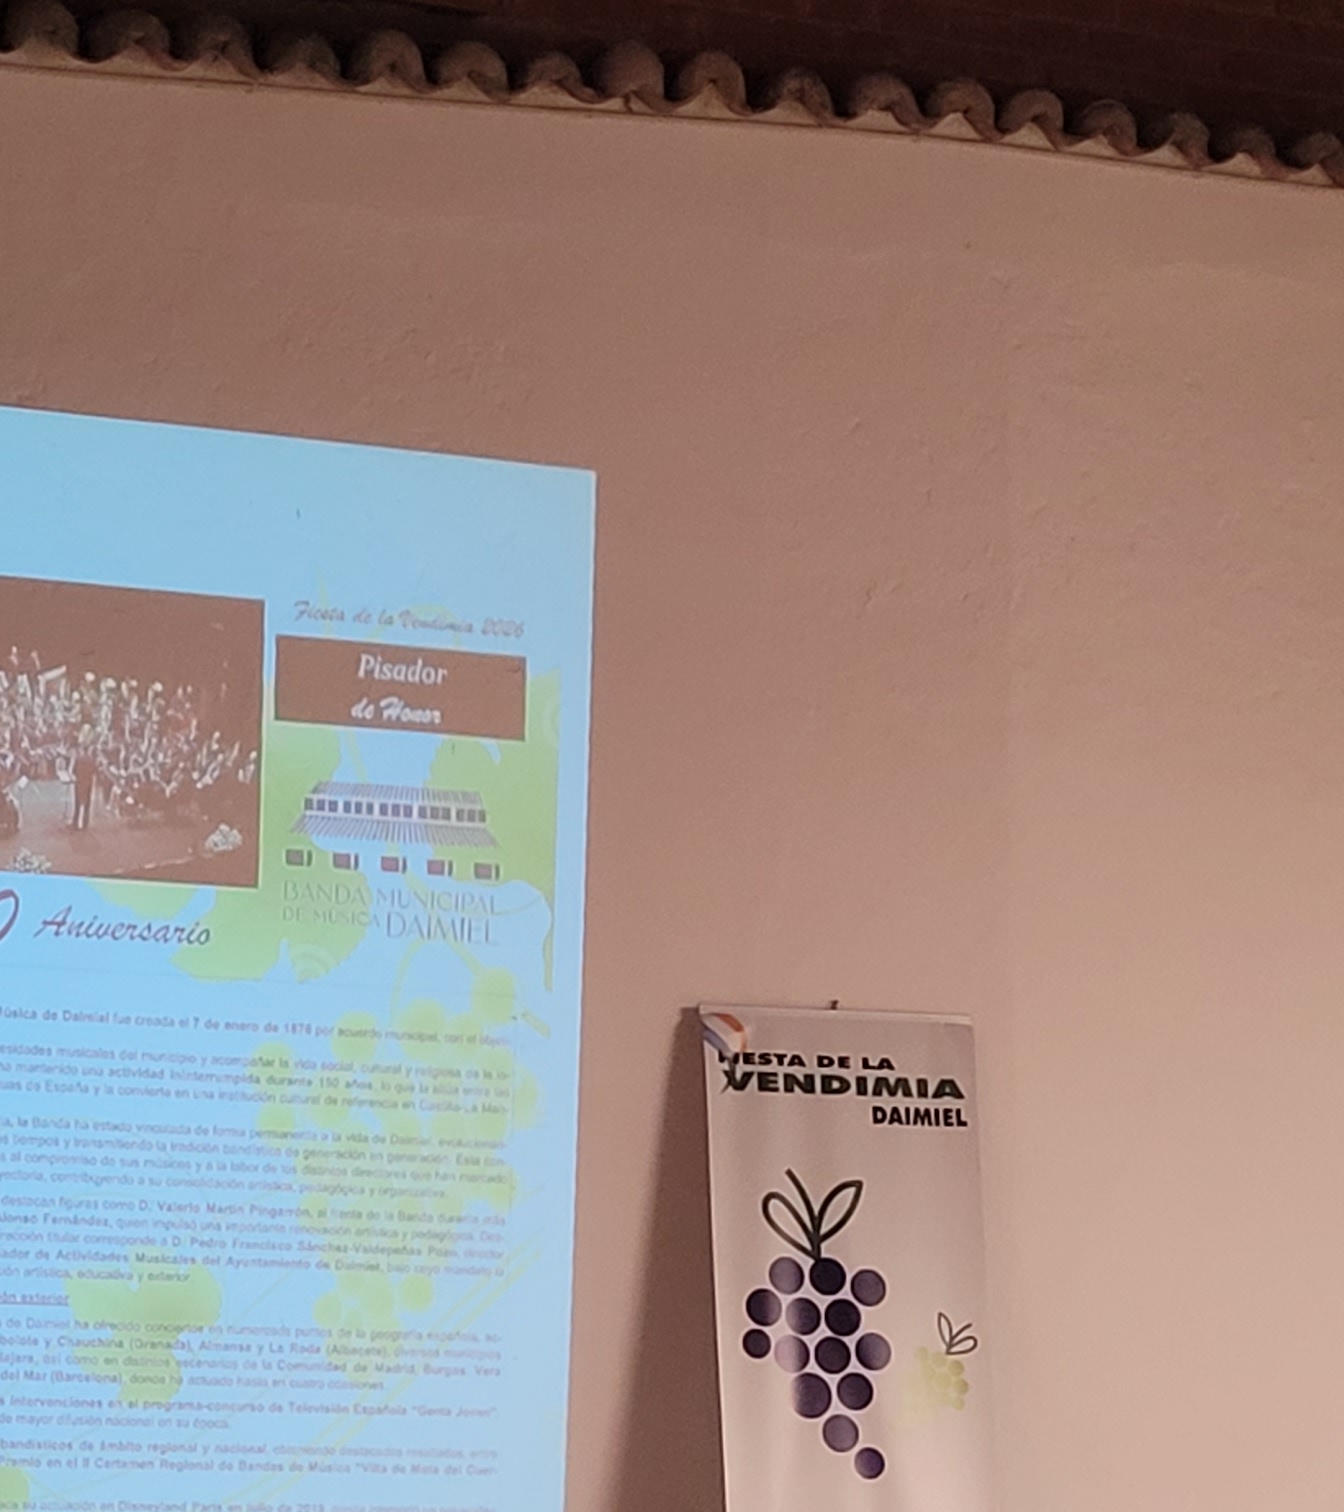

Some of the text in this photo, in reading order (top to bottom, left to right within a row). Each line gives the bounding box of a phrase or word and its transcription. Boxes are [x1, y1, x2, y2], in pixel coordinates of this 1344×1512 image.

[353, 607, 372, 625] de
[378, 609, 394, 626] la
[358, 652, 449, 686] Pisador
[351, 696, 442, 725] de Honor
[283, 879, 496, 916] BANDA MUNICIPAL
[33, 904, 212, 946] Aniversario
[386, 910, 500, 945] DAIMIEL
[816, 1055, 852, 1069] DE
[862, 1057, 896, 1071] LA
[720, 1069, 966, 1100] VENDIMIA
[871, 1106, 968, 1127] DAIMIEL
